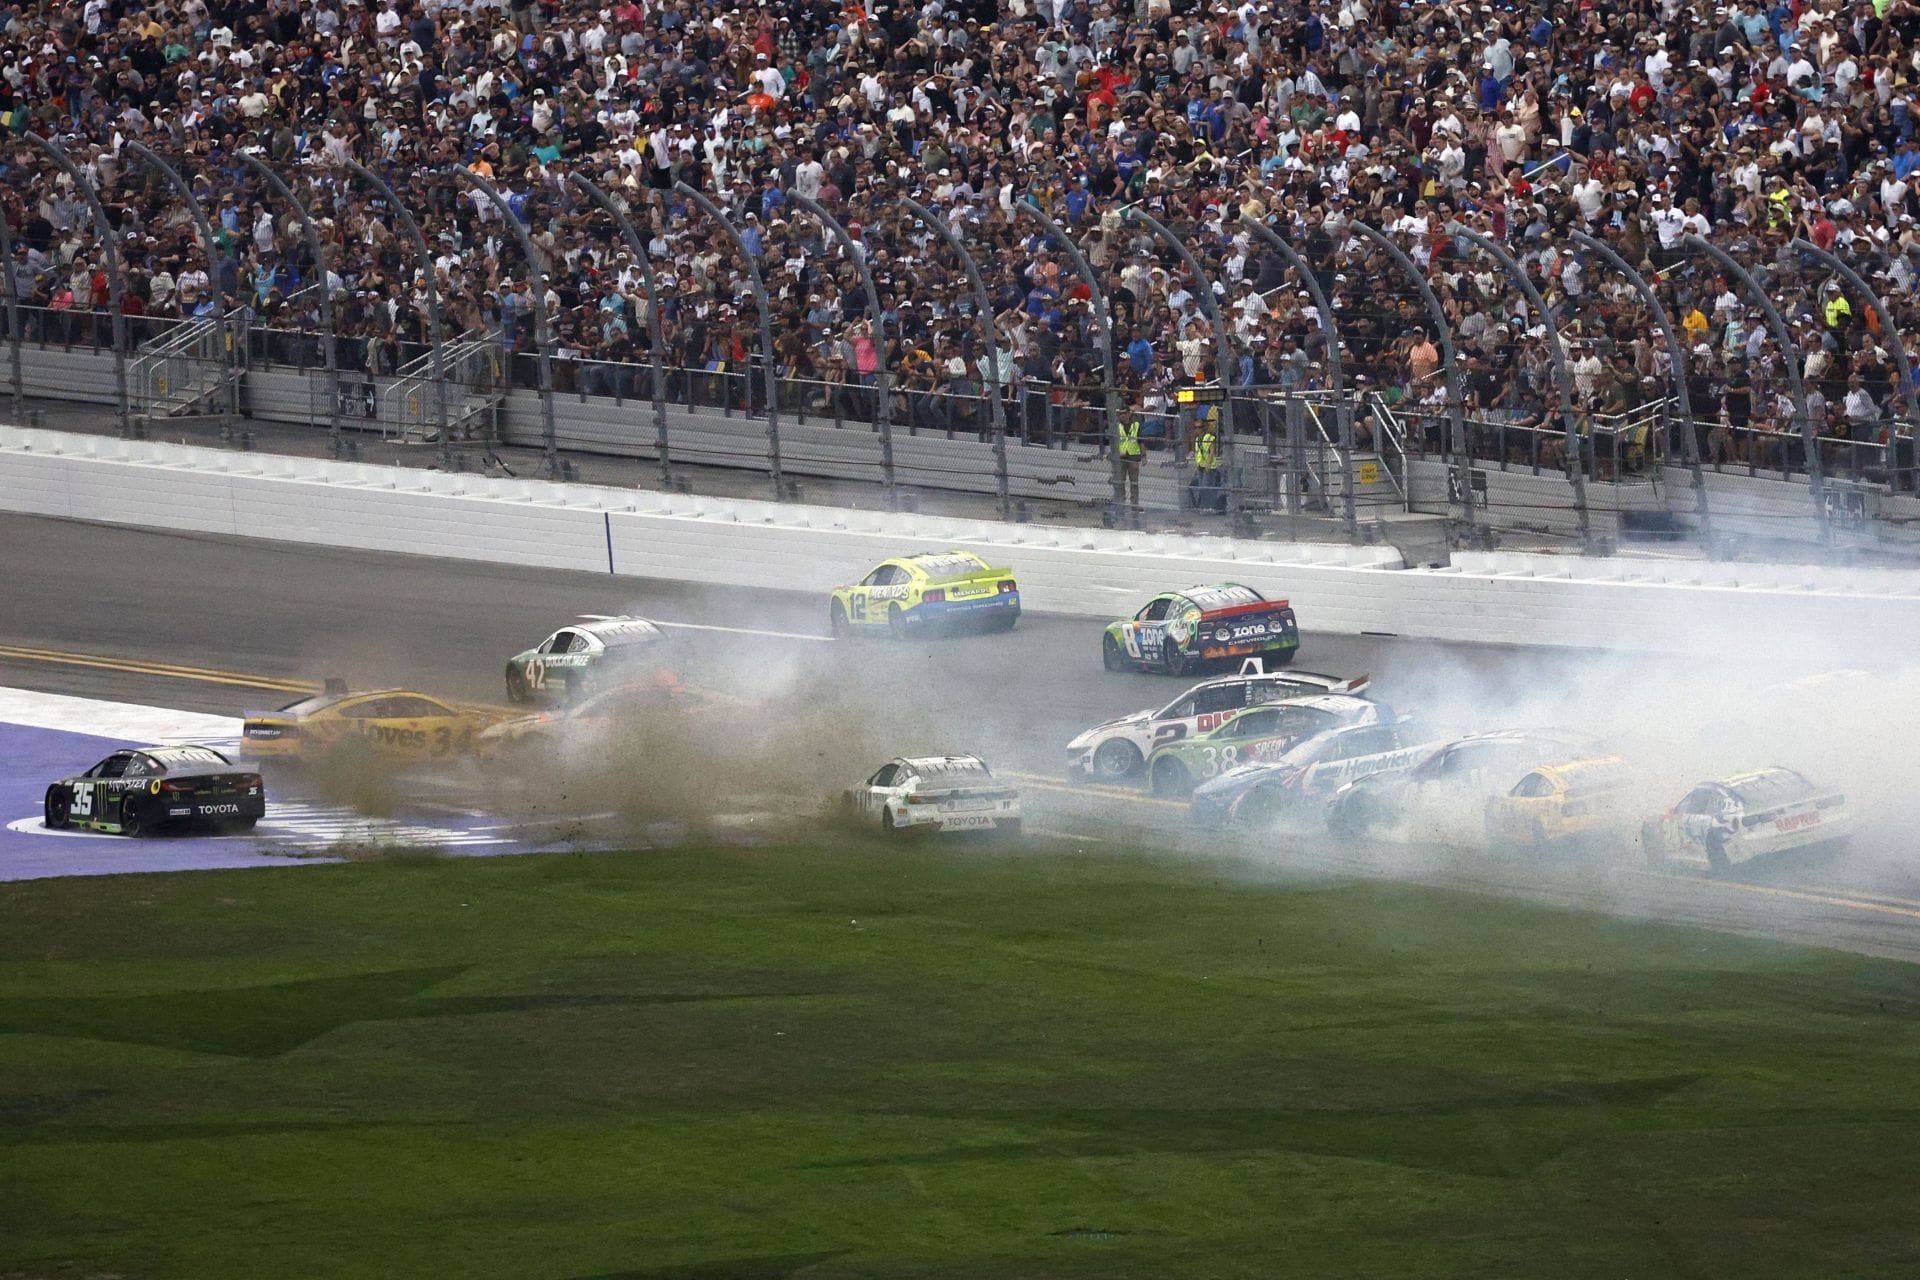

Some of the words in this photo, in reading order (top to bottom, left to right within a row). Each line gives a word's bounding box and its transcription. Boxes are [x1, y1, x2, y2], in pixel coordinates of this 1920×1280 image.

[849, 592, 866, 621] 12
[1121, 623, 1142, 659] 8
[1228, 634, 1278, 646] CHEVROLET
[525, 659, 546, 690] 42
[1201, 744, 1239, 779] 38
[70, 782, 95, 816] 35
[198, 804, 239, 815] TOYOTA
[947, 815, 990, 827] TOYOTA
